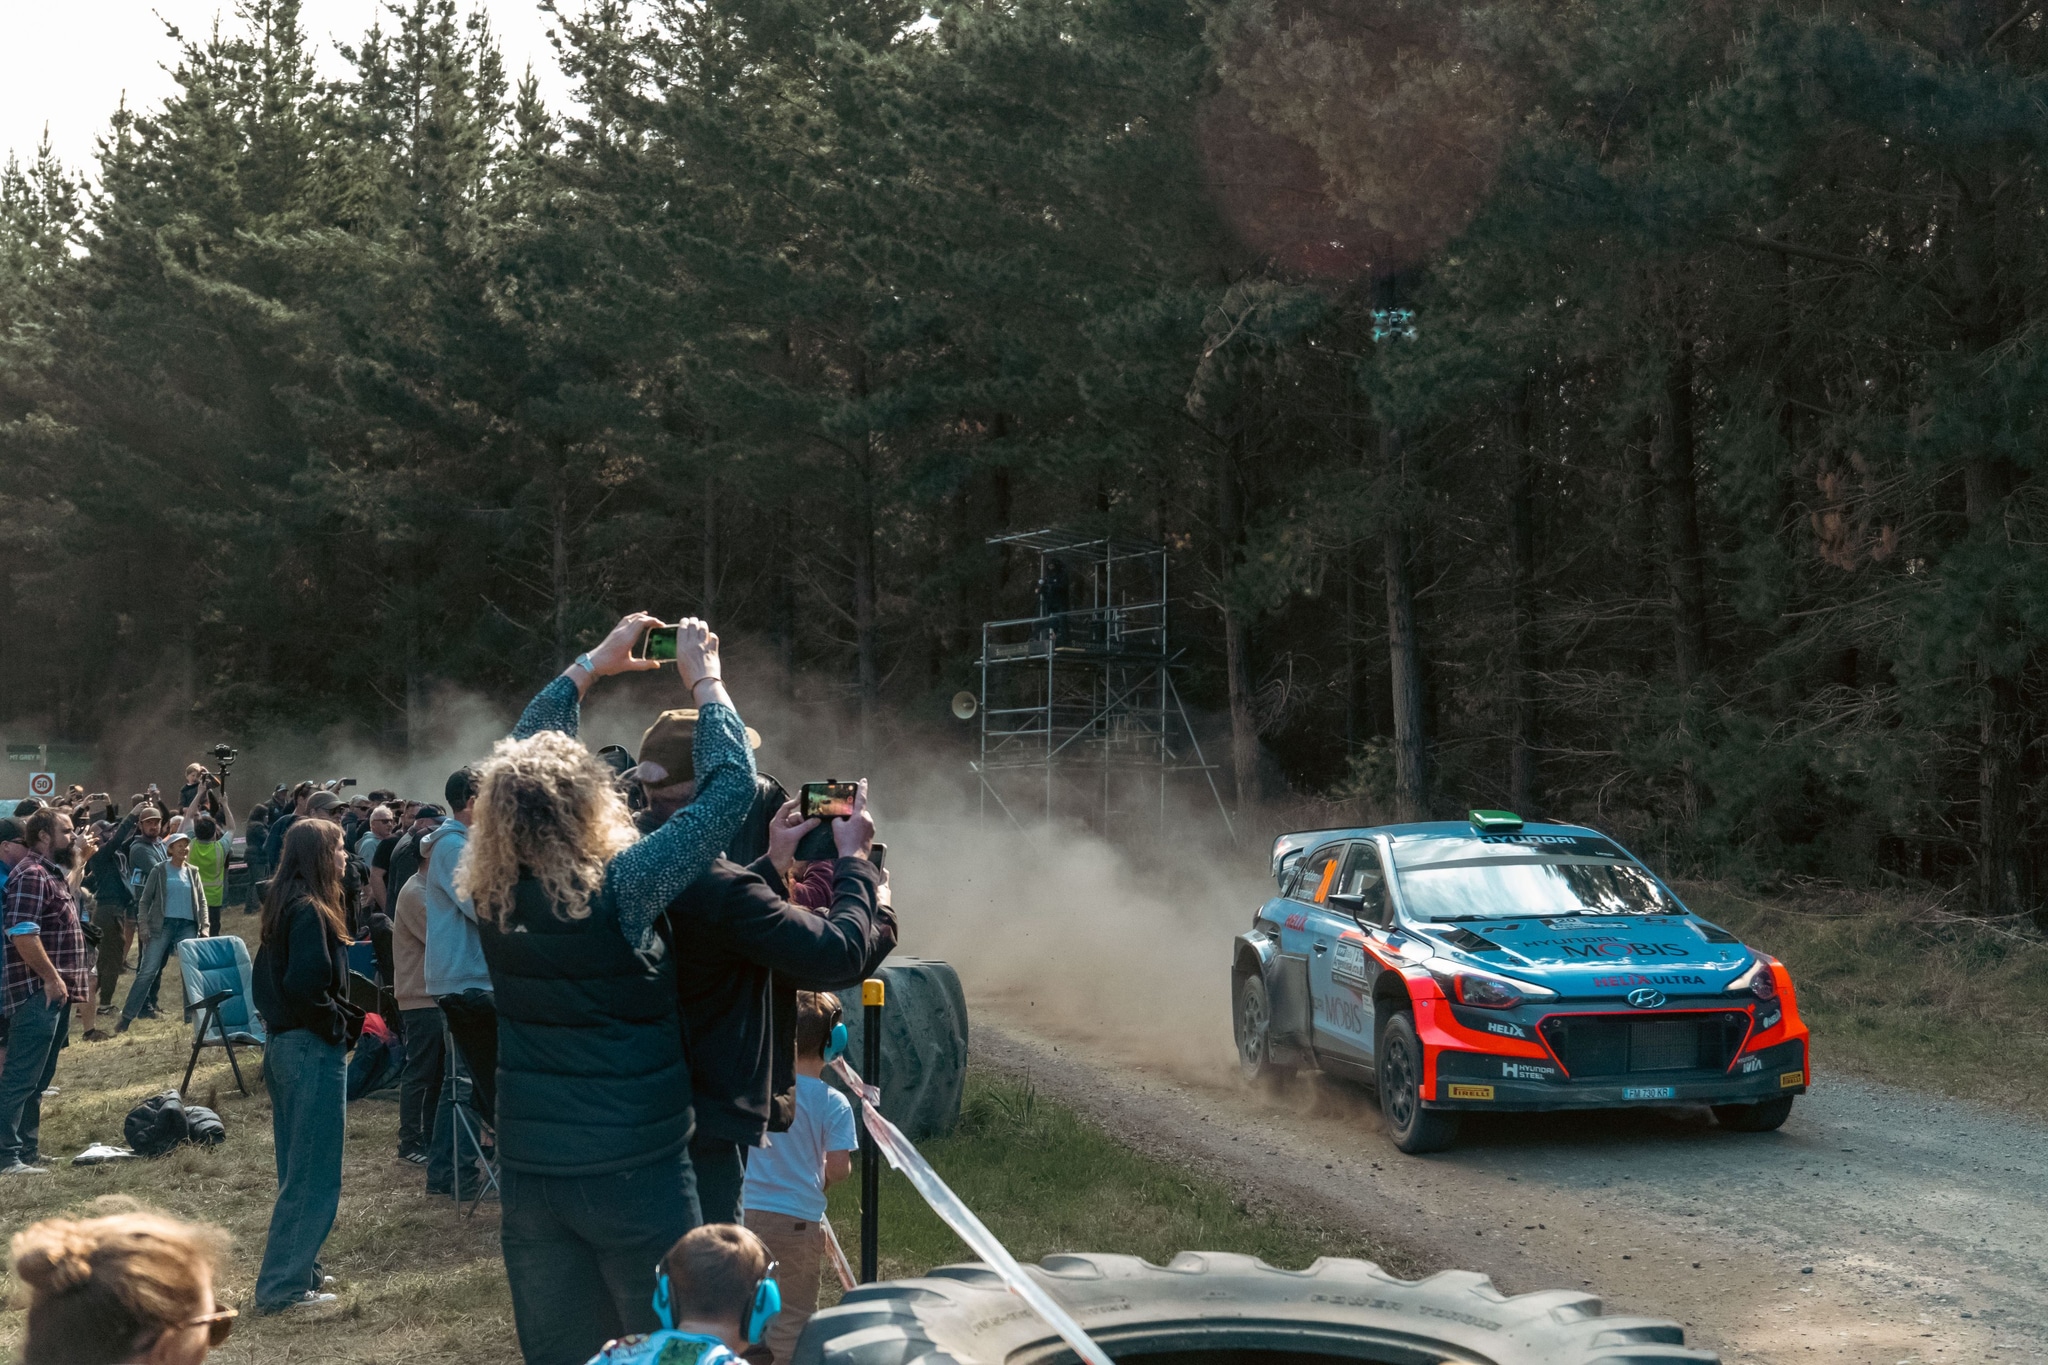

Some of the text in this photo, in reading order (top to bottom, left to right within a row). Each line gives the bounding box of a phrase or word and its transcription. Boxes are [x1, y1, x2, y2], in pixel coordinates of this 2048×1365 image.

[37, 780, 48, 789] 50
[1480, 835, 1577, 845] HYUNDAI
[1284, 911, 1308, 933] HELIX
[1523, 936, 1618, 947] HYUNDAI
[1562, 942, 1690, 957] MOBIS
[1593, 972, 1706, 987] HELIX ULTRA
[1324, 993, 1362, 1035] MOBIS
[1487, 1022, 1526, 1038] HELIX
[1519, 1064, 1555, 1074] HYUNDAI
[1519, 1072, 1546, 1080] STEEL
[1453, 1087, 1490, 1097] PIRELLI
